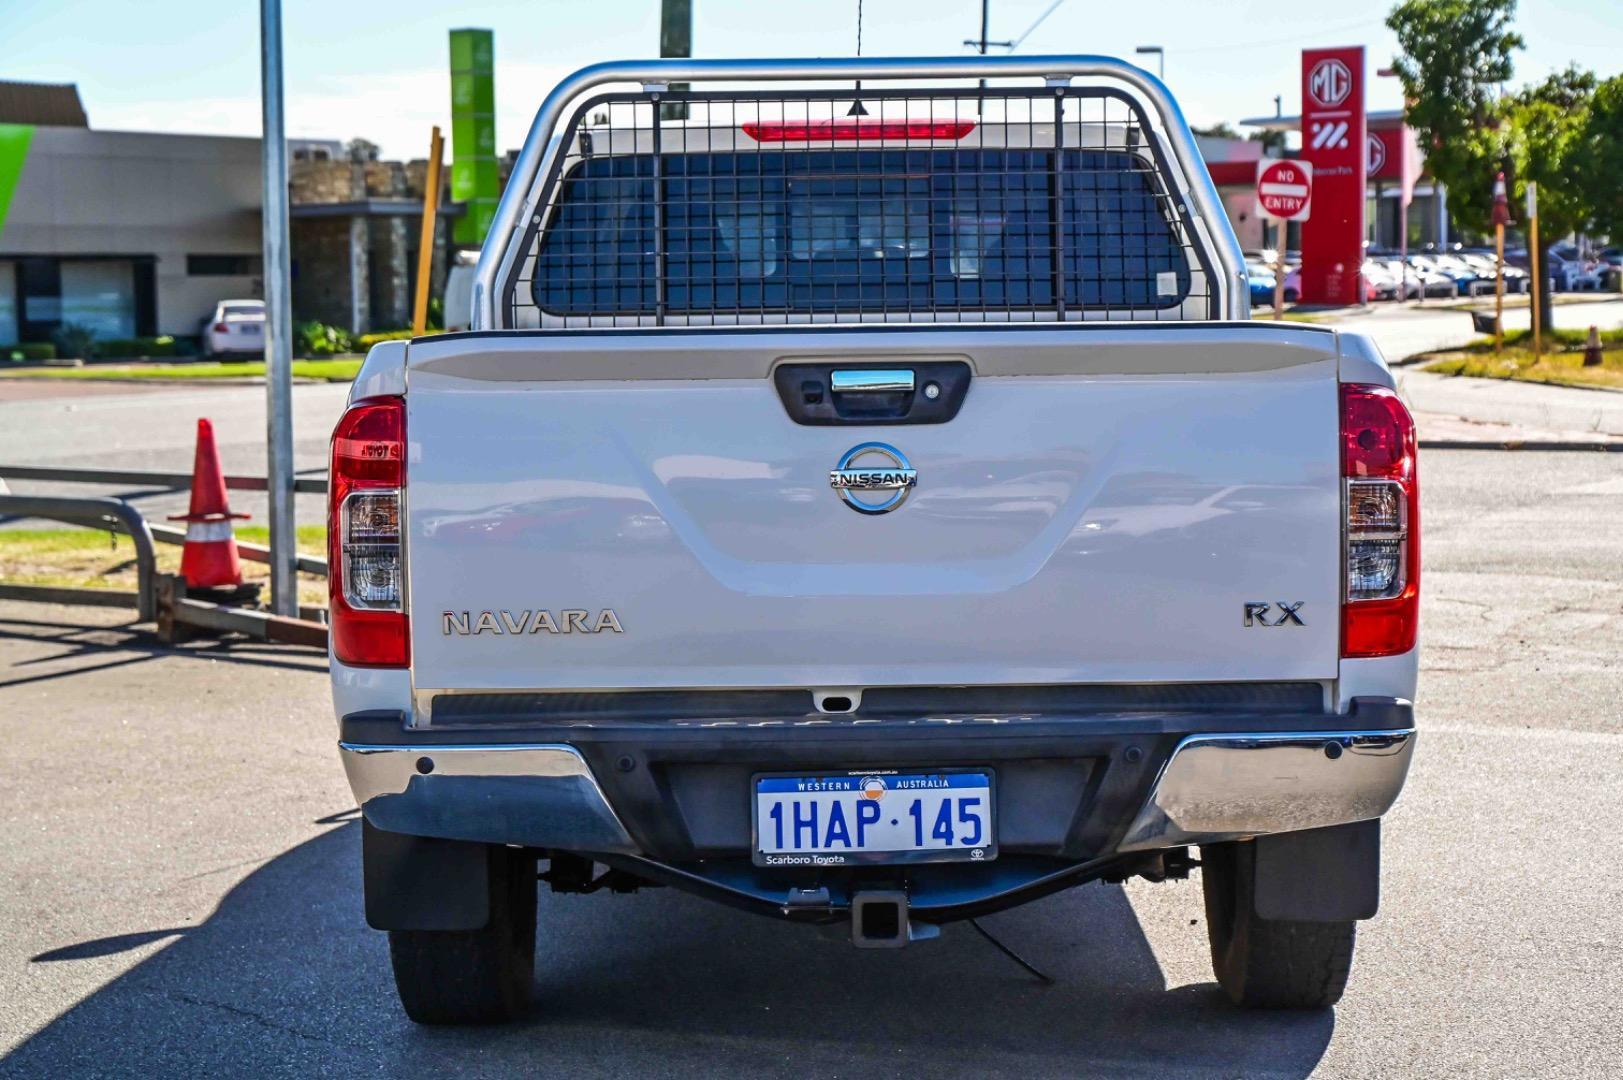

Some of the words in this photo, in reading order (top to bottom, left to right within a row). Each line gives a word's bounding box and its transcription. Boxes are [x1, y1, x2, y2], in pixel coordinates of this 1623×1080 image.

[1313, 64, 1348, 103] MG
[1277, 170, 1295, 182] NO
[1265, 196, 1303, 210] ENTRY
[839, 473, 908, 484] NISSAN
[1243, 601, 1306, 627] RX
[442, 608, 624, 636] NAVARA
[798, 782, 850, 791] WESTERN
[896, 779, 949, 789] AUSTRALIA
[766, 855, 810, 865] Scarboro
[812, 855, 845, 865] Toyota
